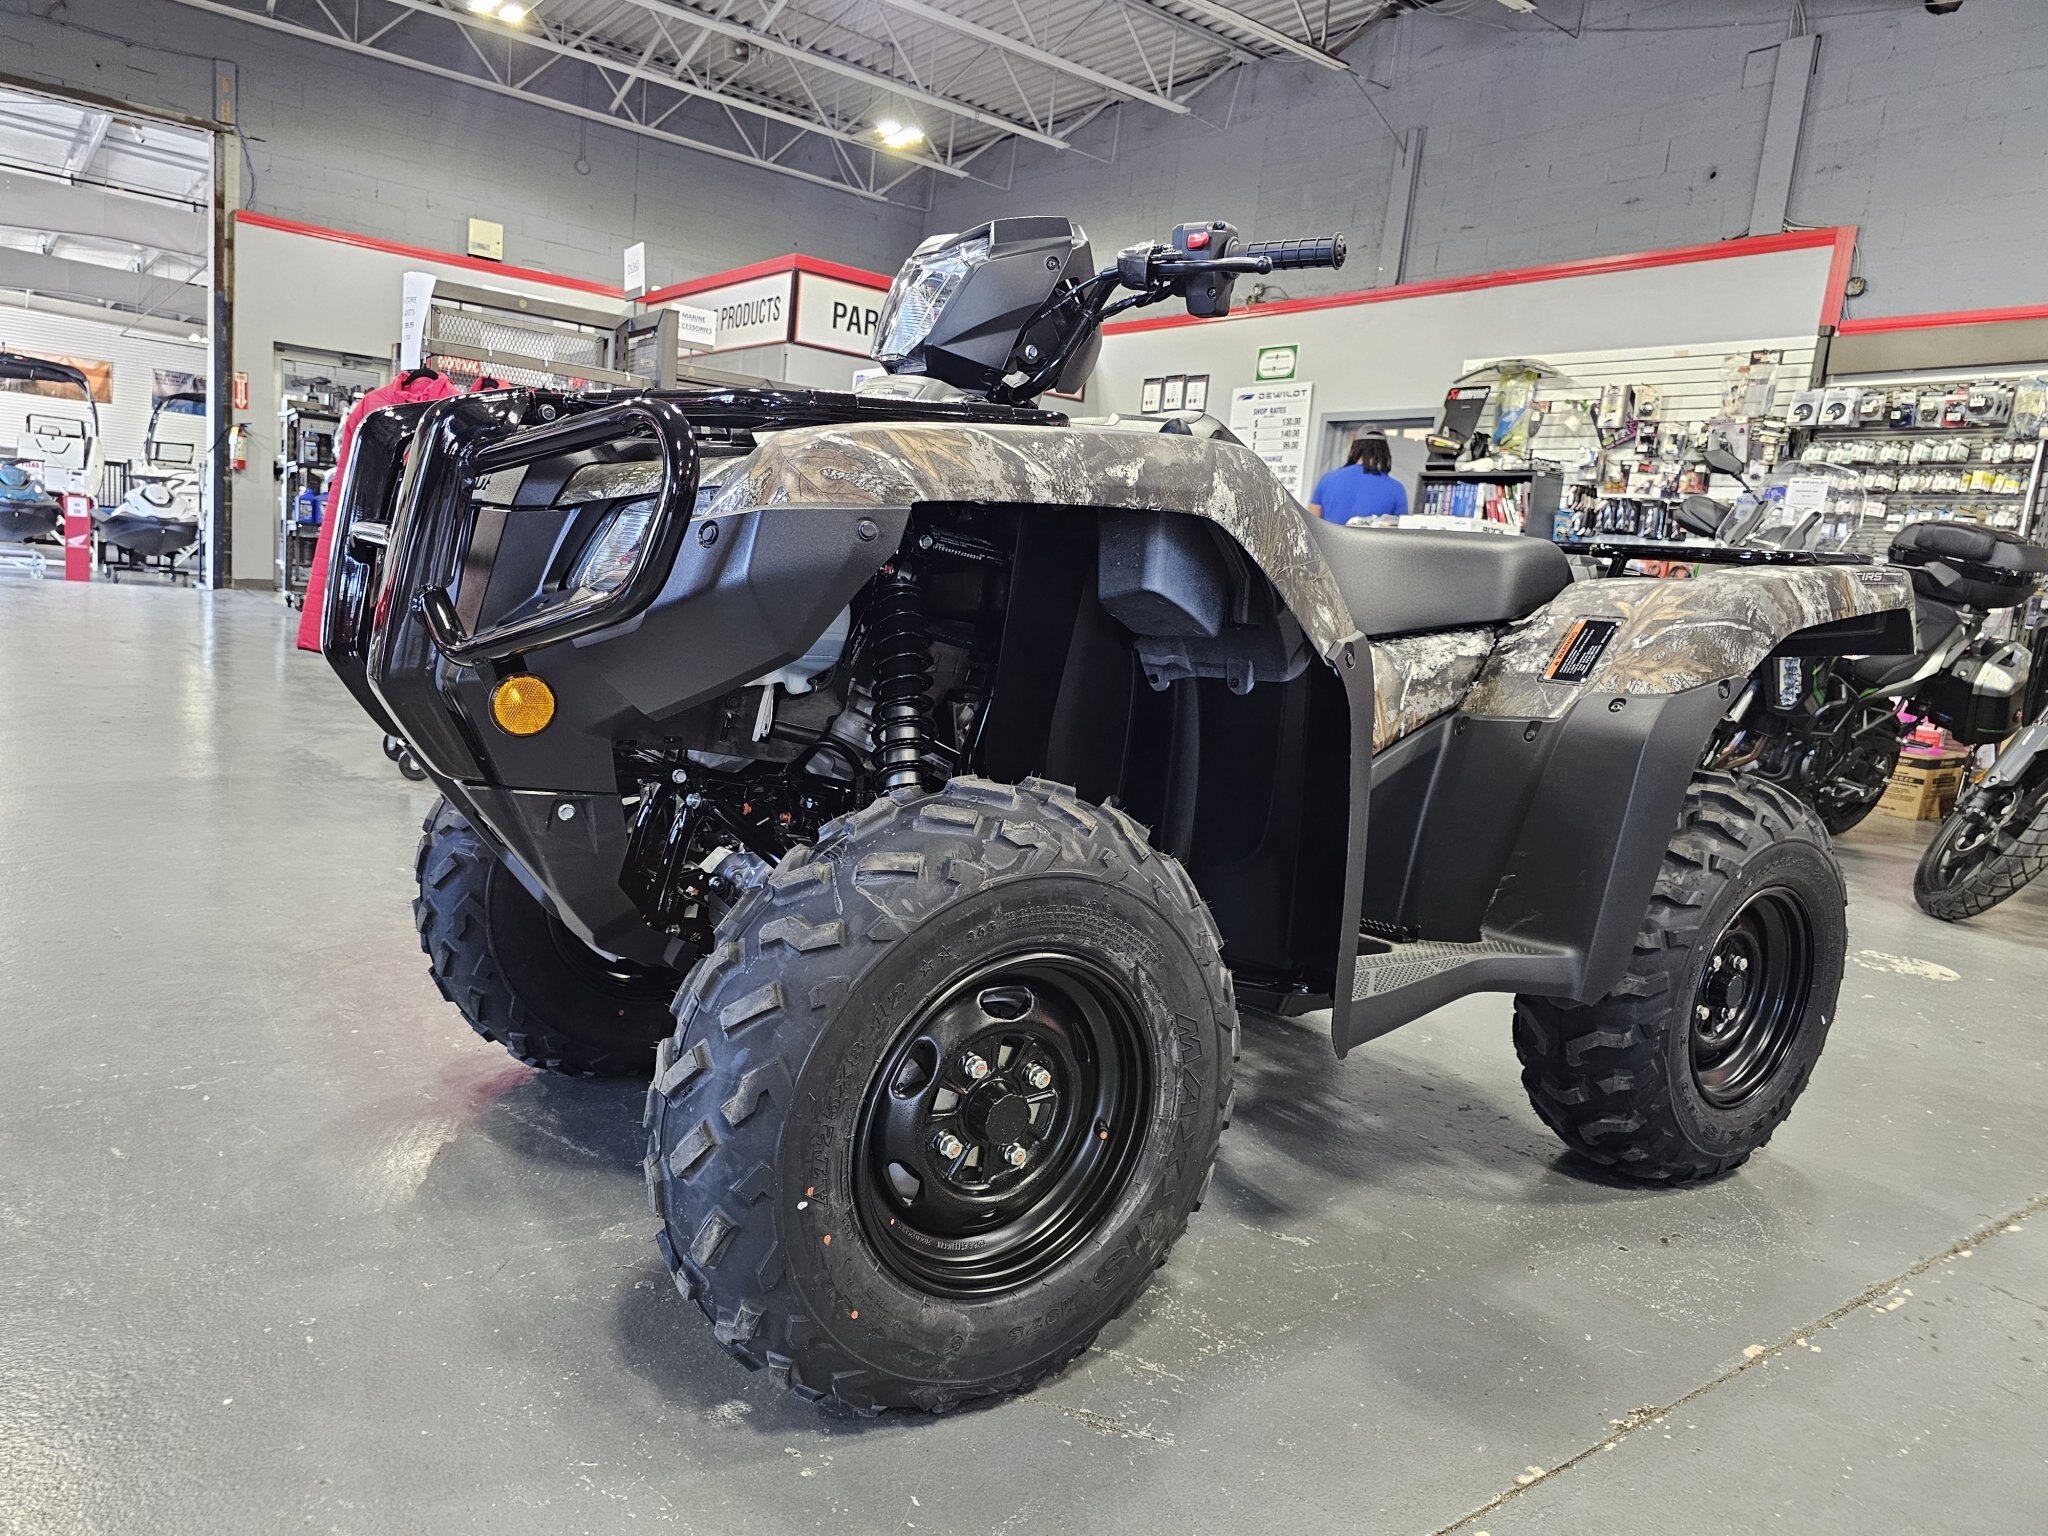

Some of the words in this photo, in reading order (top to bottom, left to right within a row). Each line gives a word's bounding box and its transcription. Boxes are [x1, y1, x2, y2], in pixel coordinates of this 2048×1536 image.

[682, 312, 705, 323] MARINE
[720, 296, 782, 331] PRODUCTS
[832, 301, 878, 336] PAR
[680, 322, 712, 335] CESSORIES
[1257, 389, 1308, 400] DEWILDT
[1253, 407, 1268, 415] SHOP
[1270, 406, 1287, 414] RATES
[1558, 631, 1578, 659] WARNING
